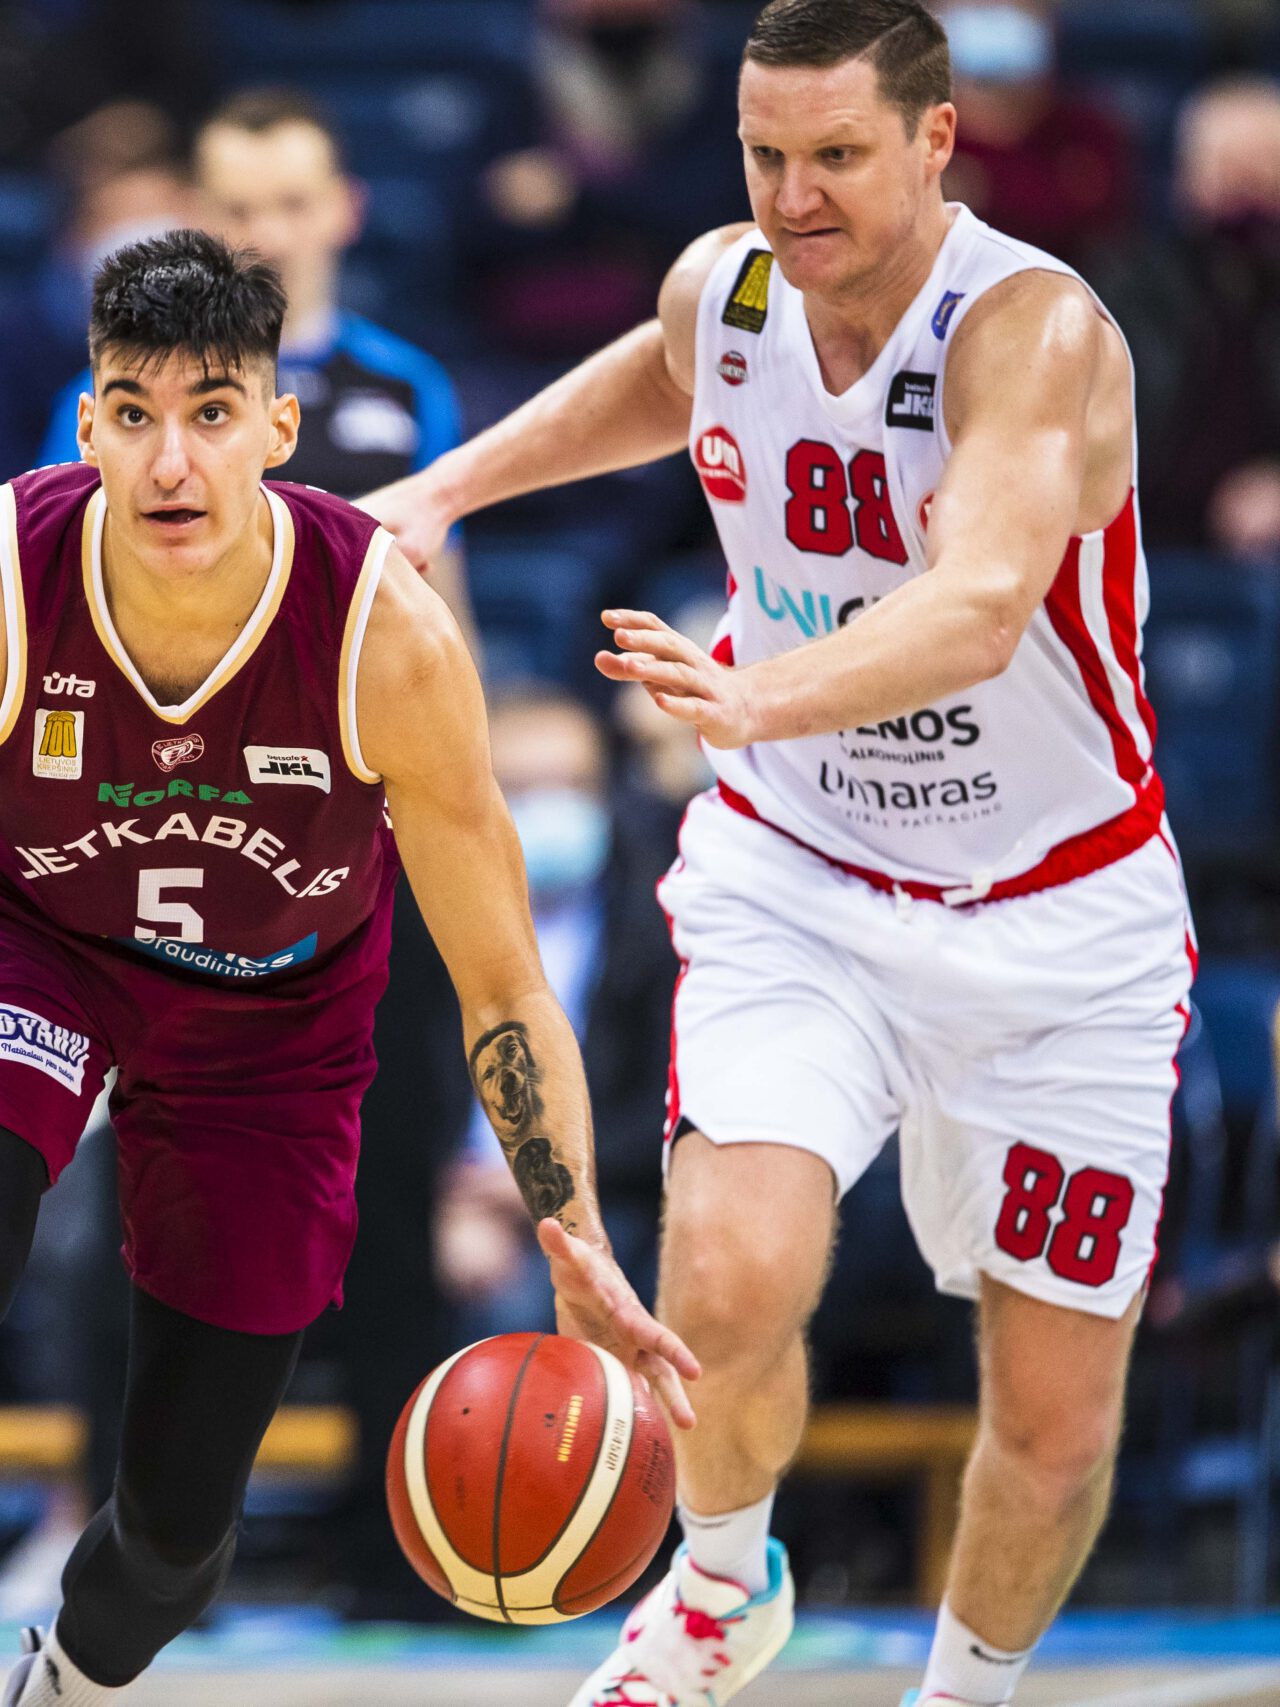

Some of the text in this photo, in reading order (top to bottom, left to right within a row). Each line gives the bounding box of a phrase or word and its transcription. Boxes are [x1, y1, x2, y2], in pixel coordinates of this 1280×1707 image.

[785, 438, 909, 566] 88
[258, 761, 324, 779] JKL
[267, 754, 300, 762] betsafe
[98, 779, 253, 807] NORFA
[134, 867, 205, 943] 5
[994, 1139, 1135, 1289] 88
